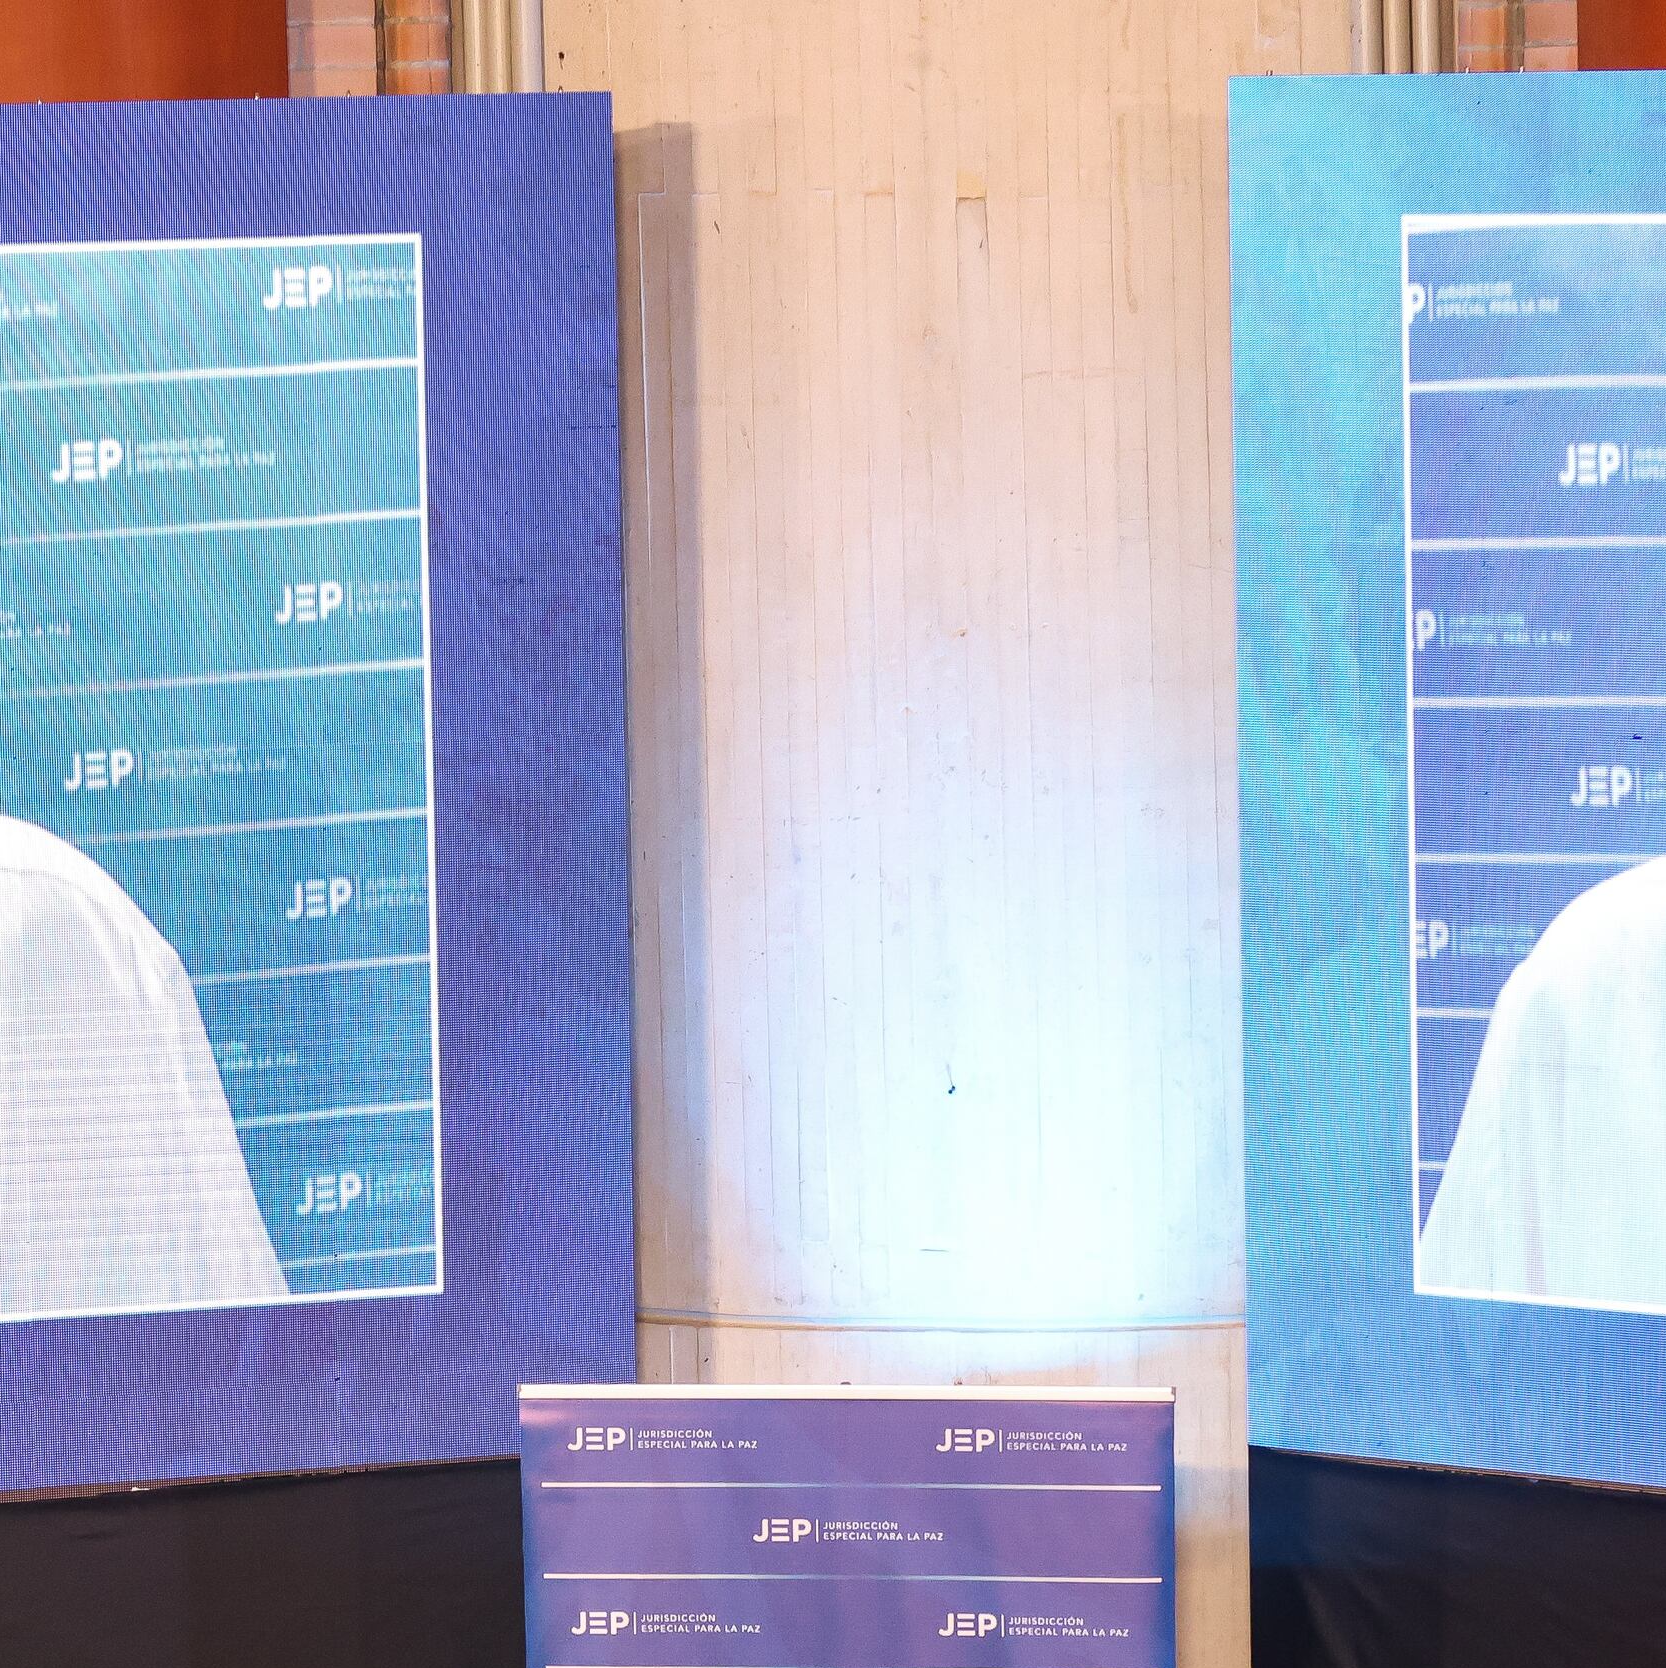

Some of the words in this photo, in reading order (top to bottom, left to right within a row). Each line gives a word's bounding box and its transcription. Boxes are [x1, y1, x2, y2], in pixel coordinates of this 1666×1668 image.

[263, 267, 333, 311] JEP
[52, 439, 123, 483] JEP
[1559, 443, 1622, 487] JEP
[276, 582, 343, 625] JEP
[66, 749, 134, 792] JEP
[1571, 765, 1631, 807] JEP
[287, 878, 353, 919] JEP
[1415, 919, 1449, 958] EP
[297, 1174, 362, 1215] JEP
[567, 1427, 626, 1451] JEP
[637, 1427, 713, 1439] JURISDICCIÓN
[637, 1440, 687, 1449] ESPECIAL
[690, 1440, 718, 1449] PARA
[721, 1440, 735, 1449] LA
[738, 1440, 758, 1449] PAZ
[935, 1428, 996, 1453] JEP
[1006, 1429, 1082, 1441] JURISDICCIÓN
[1006, 1441, 1056, 1451] ESPECIAL
[1060, 1442, 1087, 1451] PARA
[1091, 1443, 1104, 1452] LA
[1108, 1442, 1128, 1452] PAZ
[752, 1518, 812, 1543] JEP
[822, 1519, 898, 1531] JURISDICCIÓN
[823, 1531, 873, 1541] ESPECIAL
[876, 1532, 904, 1541] PARA
[907, 1532, 921, 1541] LA
[923, 1532, 944, 1541] PAZ
[571, 1611, 630, 1635] JEP
[640, 1611, 716, 1623] JURISDICCIÓN
[641, 1624, 690, 1633] ESPECIAL
[694, 1624, 721, 1633] PARA
[724, 1624, 738, 1633] LA
[741, 1624, 761, 1633] PAZ
[938, 1612, 998, 1637] JEP
[1008, 1615, 1084, 1626] JURISDICCIÓN
[1008, 1627, 1058, 1636] ESPECIAL
[1062, 1627, 1089, 1637] PARA
[1092, 1628, 1106, 1637] LA
[1109, 1628, 1129, 1638] PAZ
